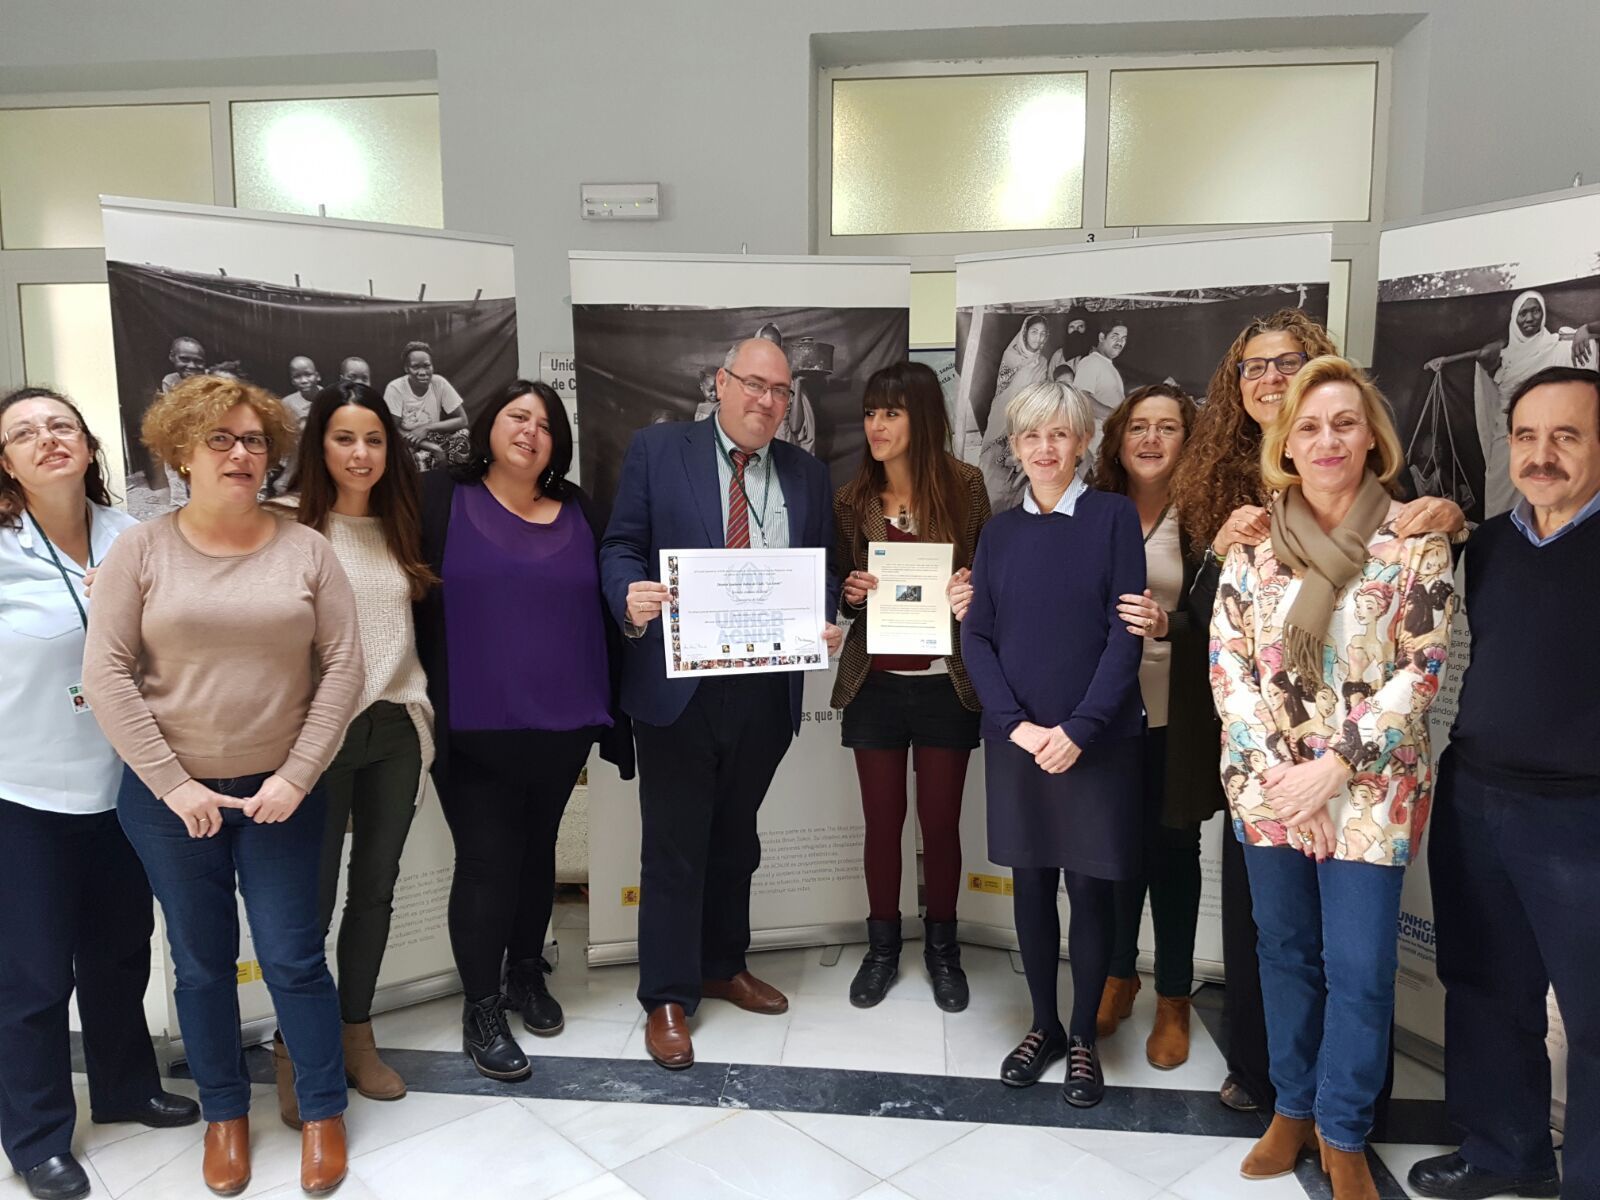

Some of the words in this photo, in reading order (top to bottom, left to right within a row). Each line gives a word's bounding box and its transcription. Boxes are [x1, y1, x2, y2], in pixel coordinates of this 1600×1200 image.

[1086, 233, 1095, 243] 3
[552, 378, 565, 390] de
[715, 610, 784, 628] UNHCR
[718, 628, 785, 645] ACNUR
[814, 711, 833, 723] que
